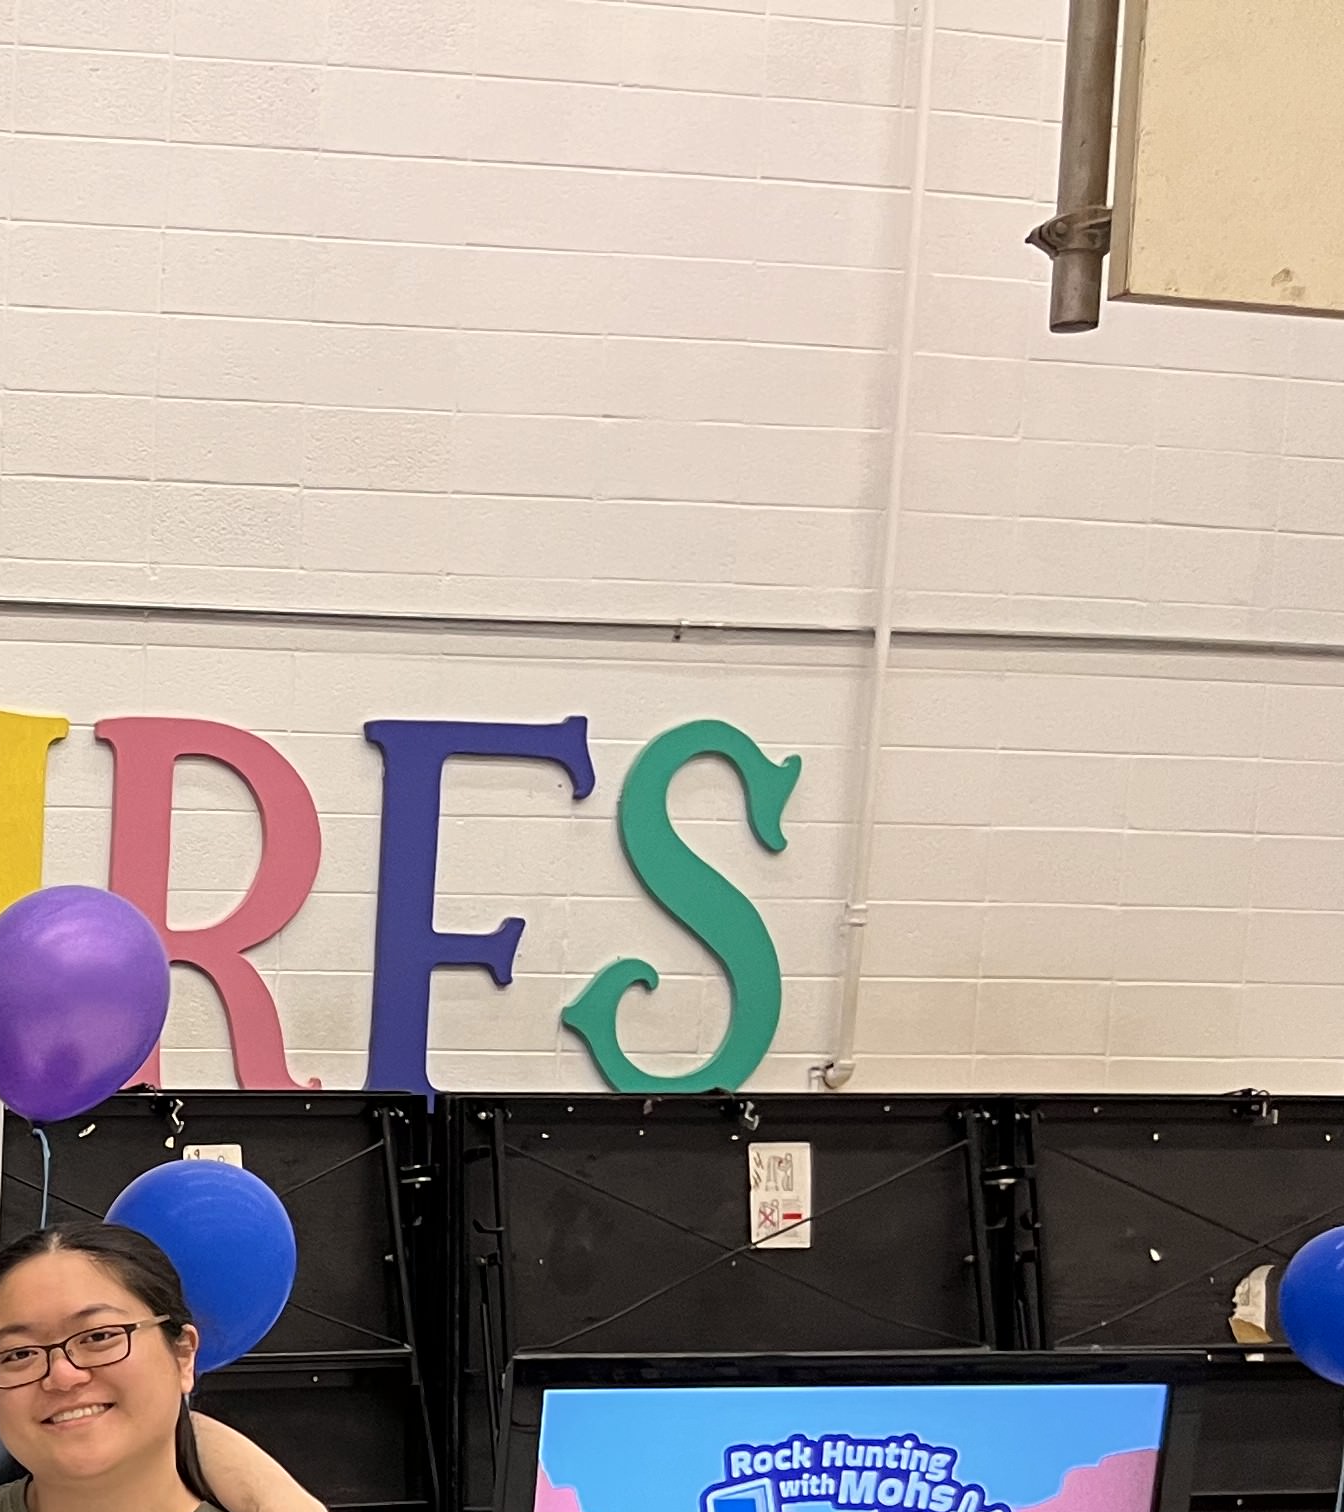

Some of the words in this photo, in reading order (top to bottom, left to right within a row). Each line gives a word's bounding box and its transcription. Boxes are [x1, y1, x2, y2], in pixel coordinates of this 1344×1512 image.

[730, 1440, 812, 1479] Rock
[823, 1440, 952, 1482] Hunting
[779, 1473, 835, 1498] with
[838, 1470, 957, 1512] Mohs
